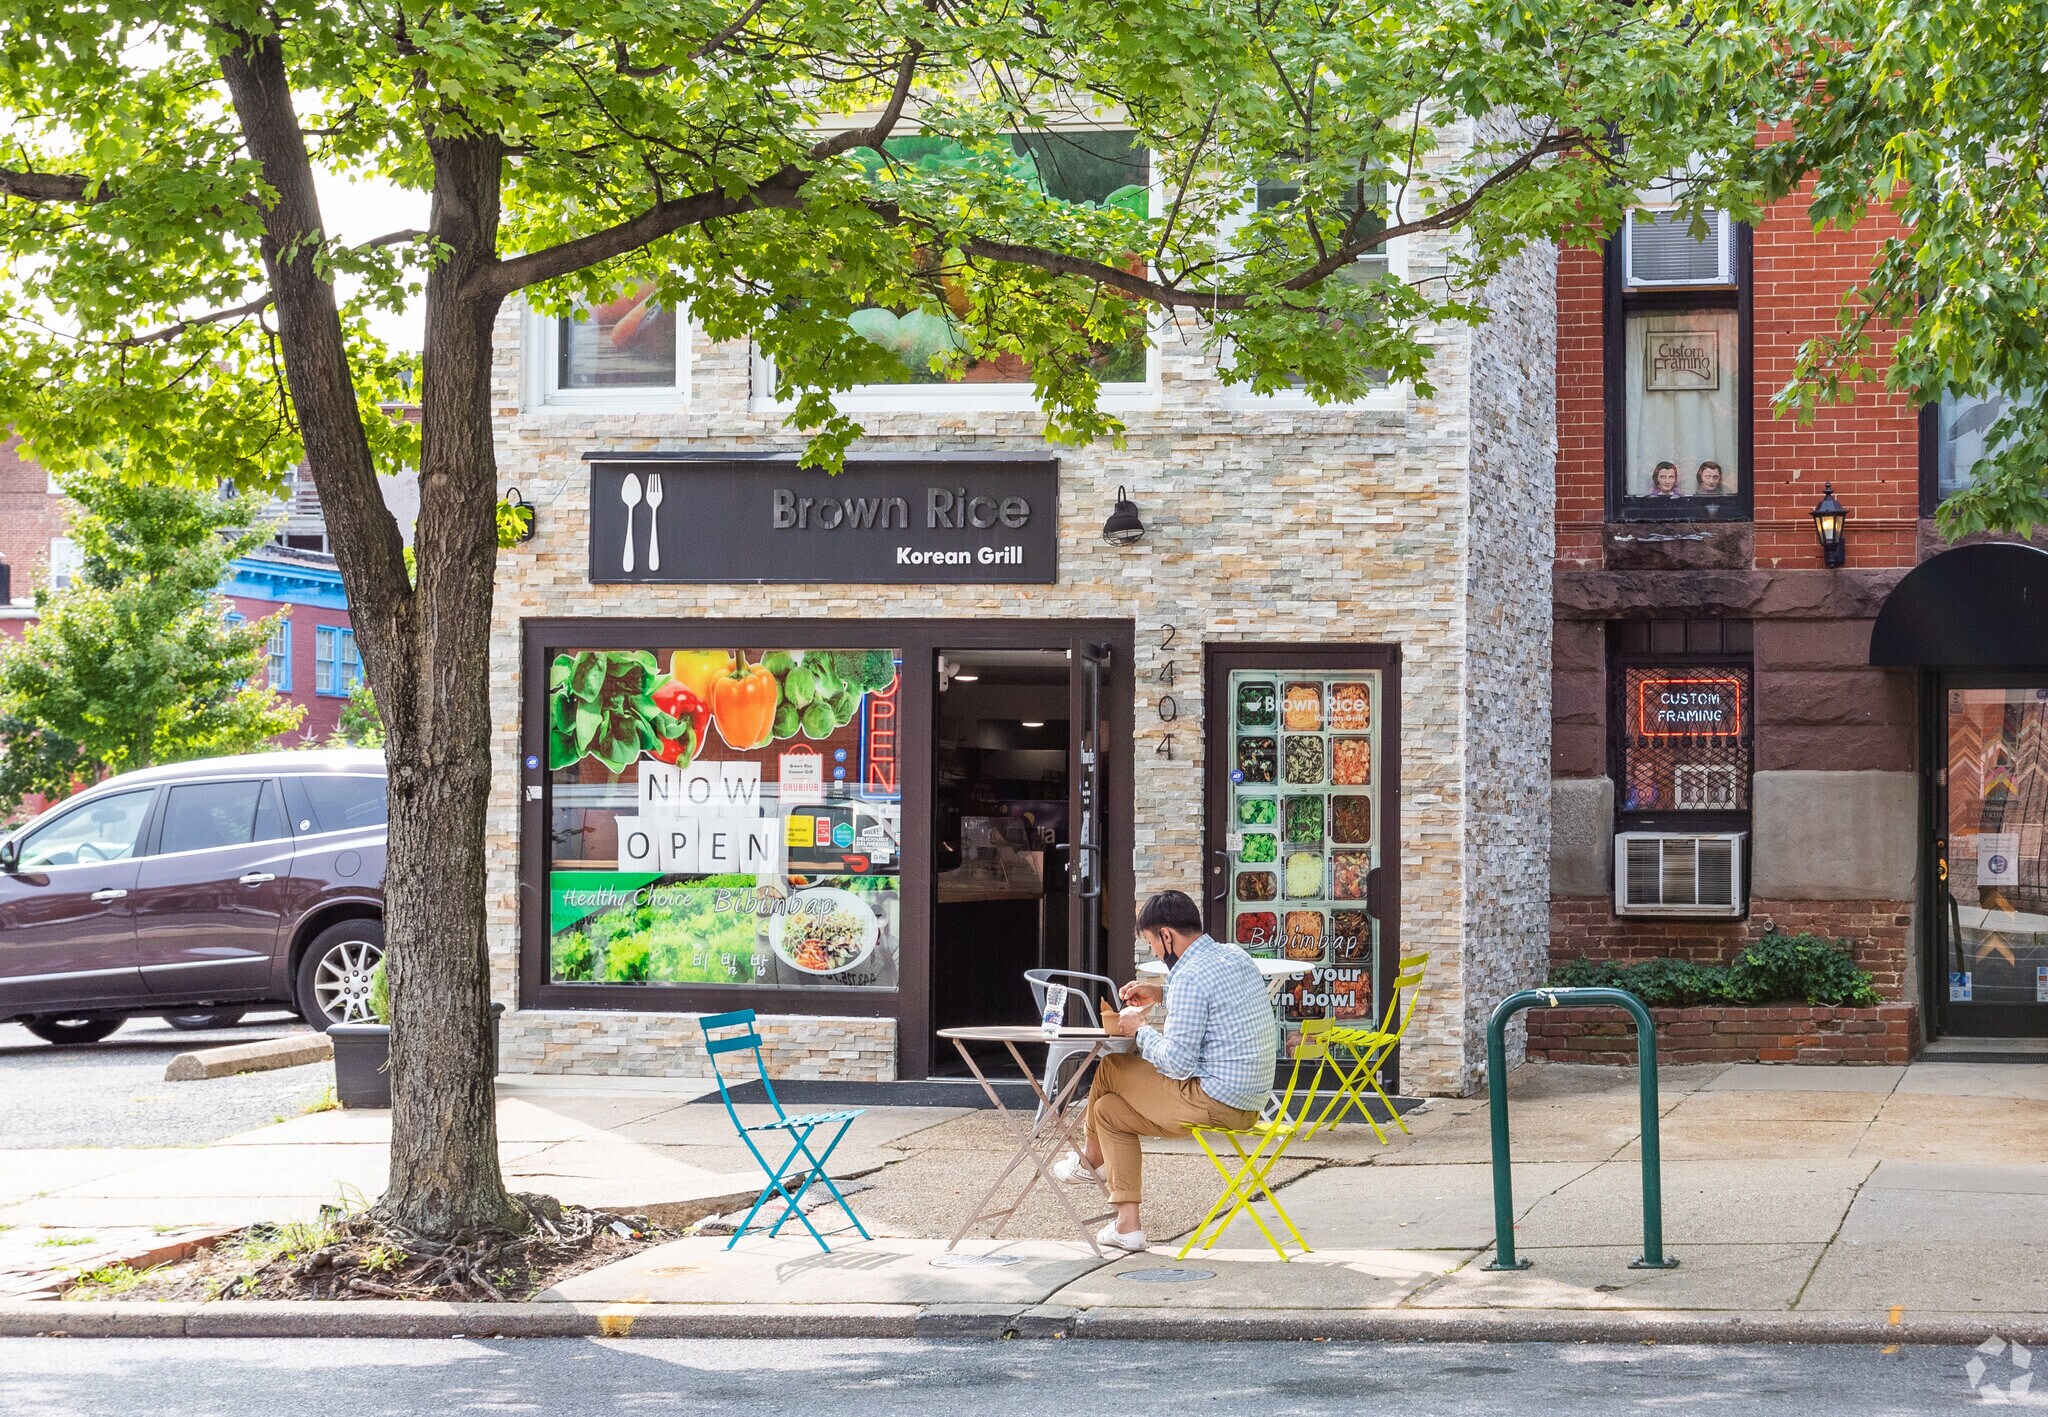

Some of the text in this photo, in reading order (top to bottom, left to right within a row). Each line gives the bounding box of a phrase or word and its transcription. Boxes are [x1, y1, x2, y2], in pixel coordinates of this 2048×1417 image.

[1658, 342, 1704, 357] Custom
[1654, 357, 1711, 380] Framing
[773, 487, 1031, 531] Brown Rice
[896, 546, 1023, 566] Korean Grill
[1265, 695, 1320, 712] Brown
[1327, 695, 1366, 712] Rice
[1660, 692, 1720, 705] CUSTOM
[1314, 714, 1344, 722] Koean
[1657, 709, 1723, 722] FRAMING
[649, 774, 757, 804] NOW
[783, 783, 819, 791] GRUBHUB
[627, 832, 768, 860] OPEN
[563, 884, 692, 913] Healthy Choice
[714, 885, 833, 926] Bibimbap
[1249, 925, 1358, 958] Bibimbap
[1311, 967, 1361, 986] your
[1302, 989, 1356, 1007] bowl
